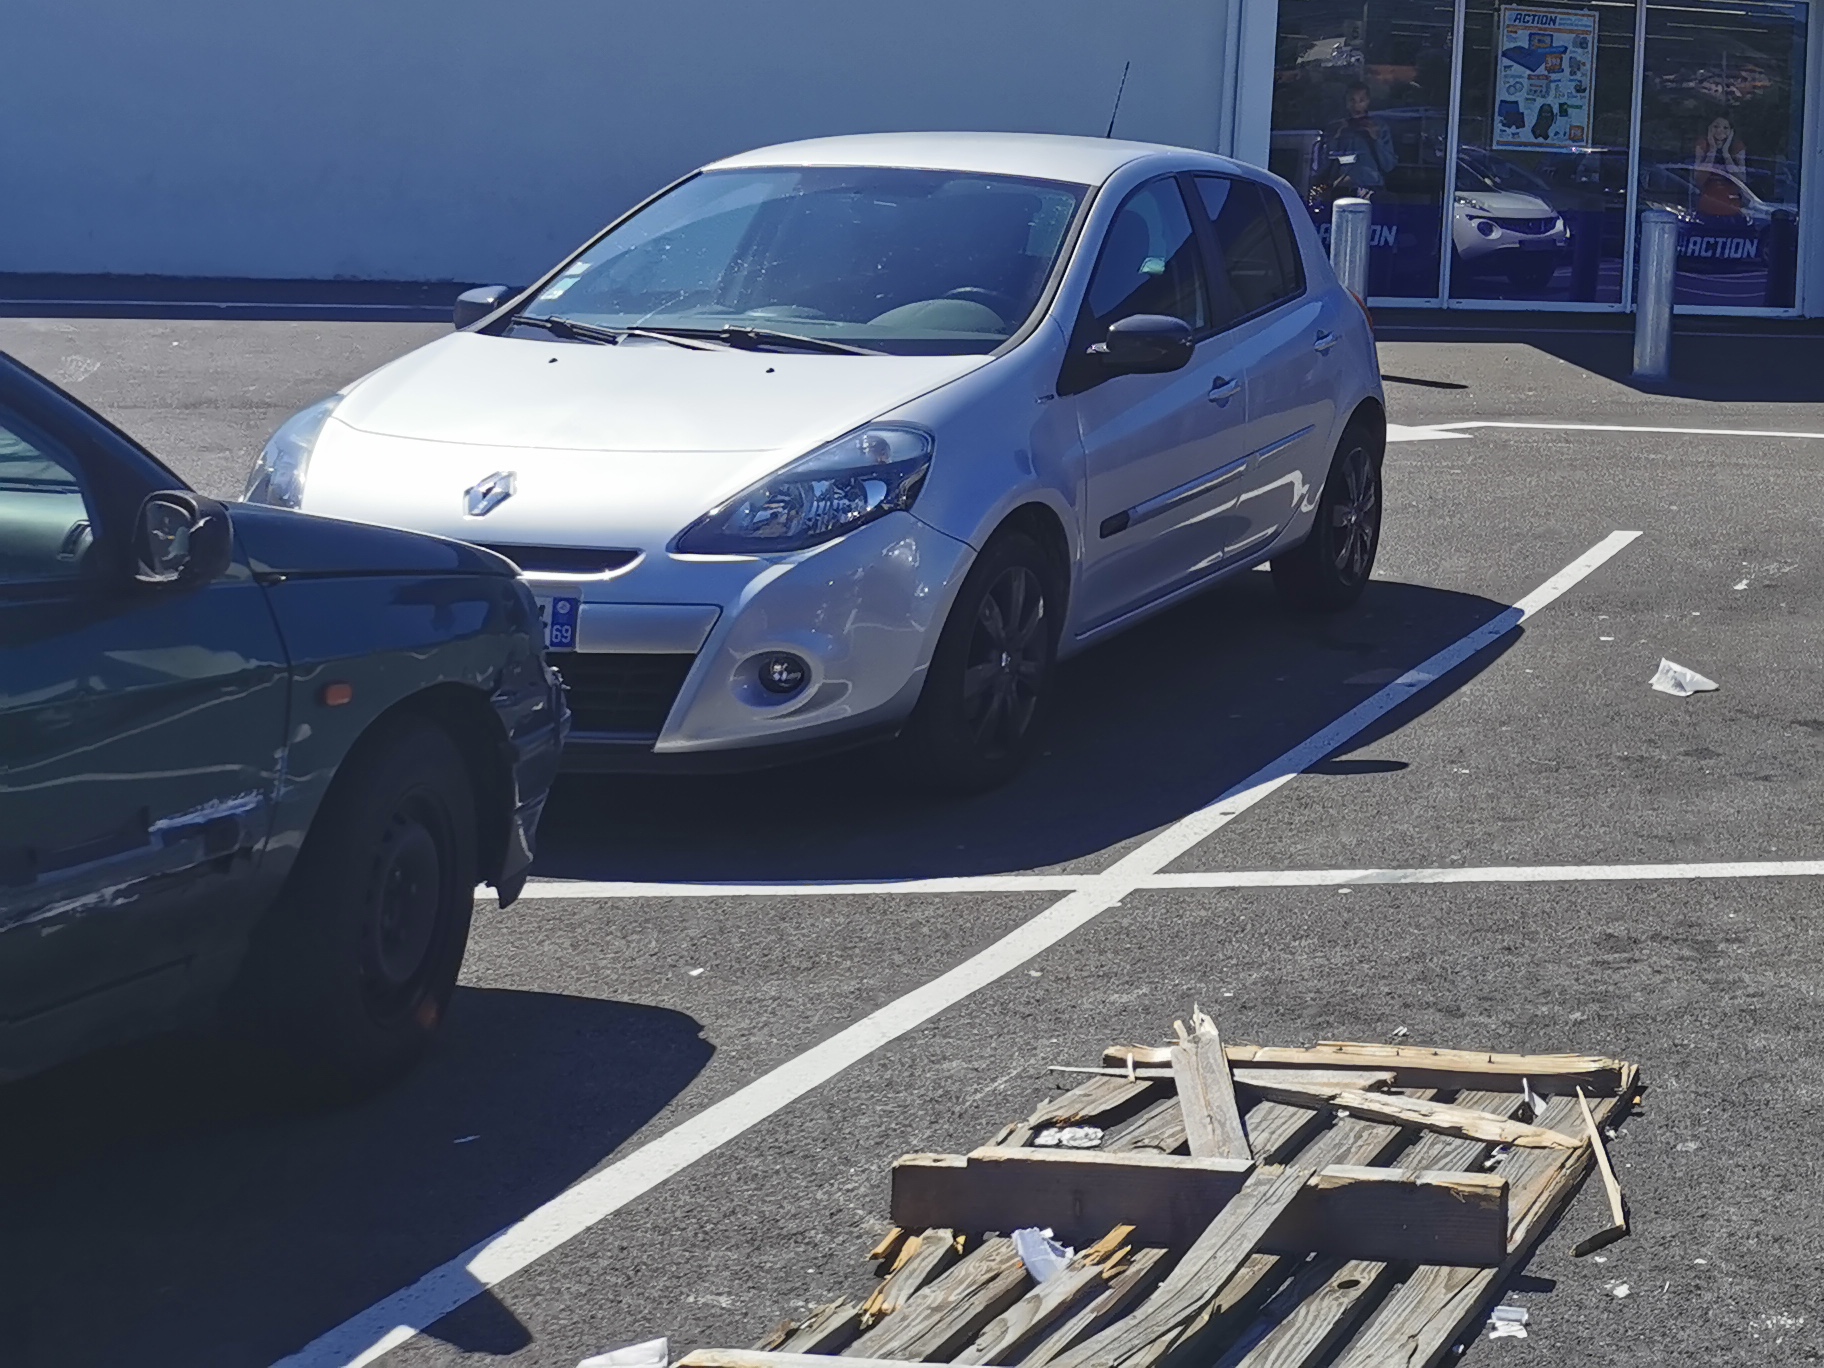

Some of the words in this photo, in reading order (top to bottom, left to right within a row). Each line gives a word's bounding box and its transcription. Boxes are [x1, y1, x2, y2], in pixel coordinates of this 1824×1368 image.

[1513, 12, 1558, 26] ACTION
[1319, 223, 1397, 246] AON
[1686, 236, 1759, 259] ACTION
[552, 624, 572, 644] 69
